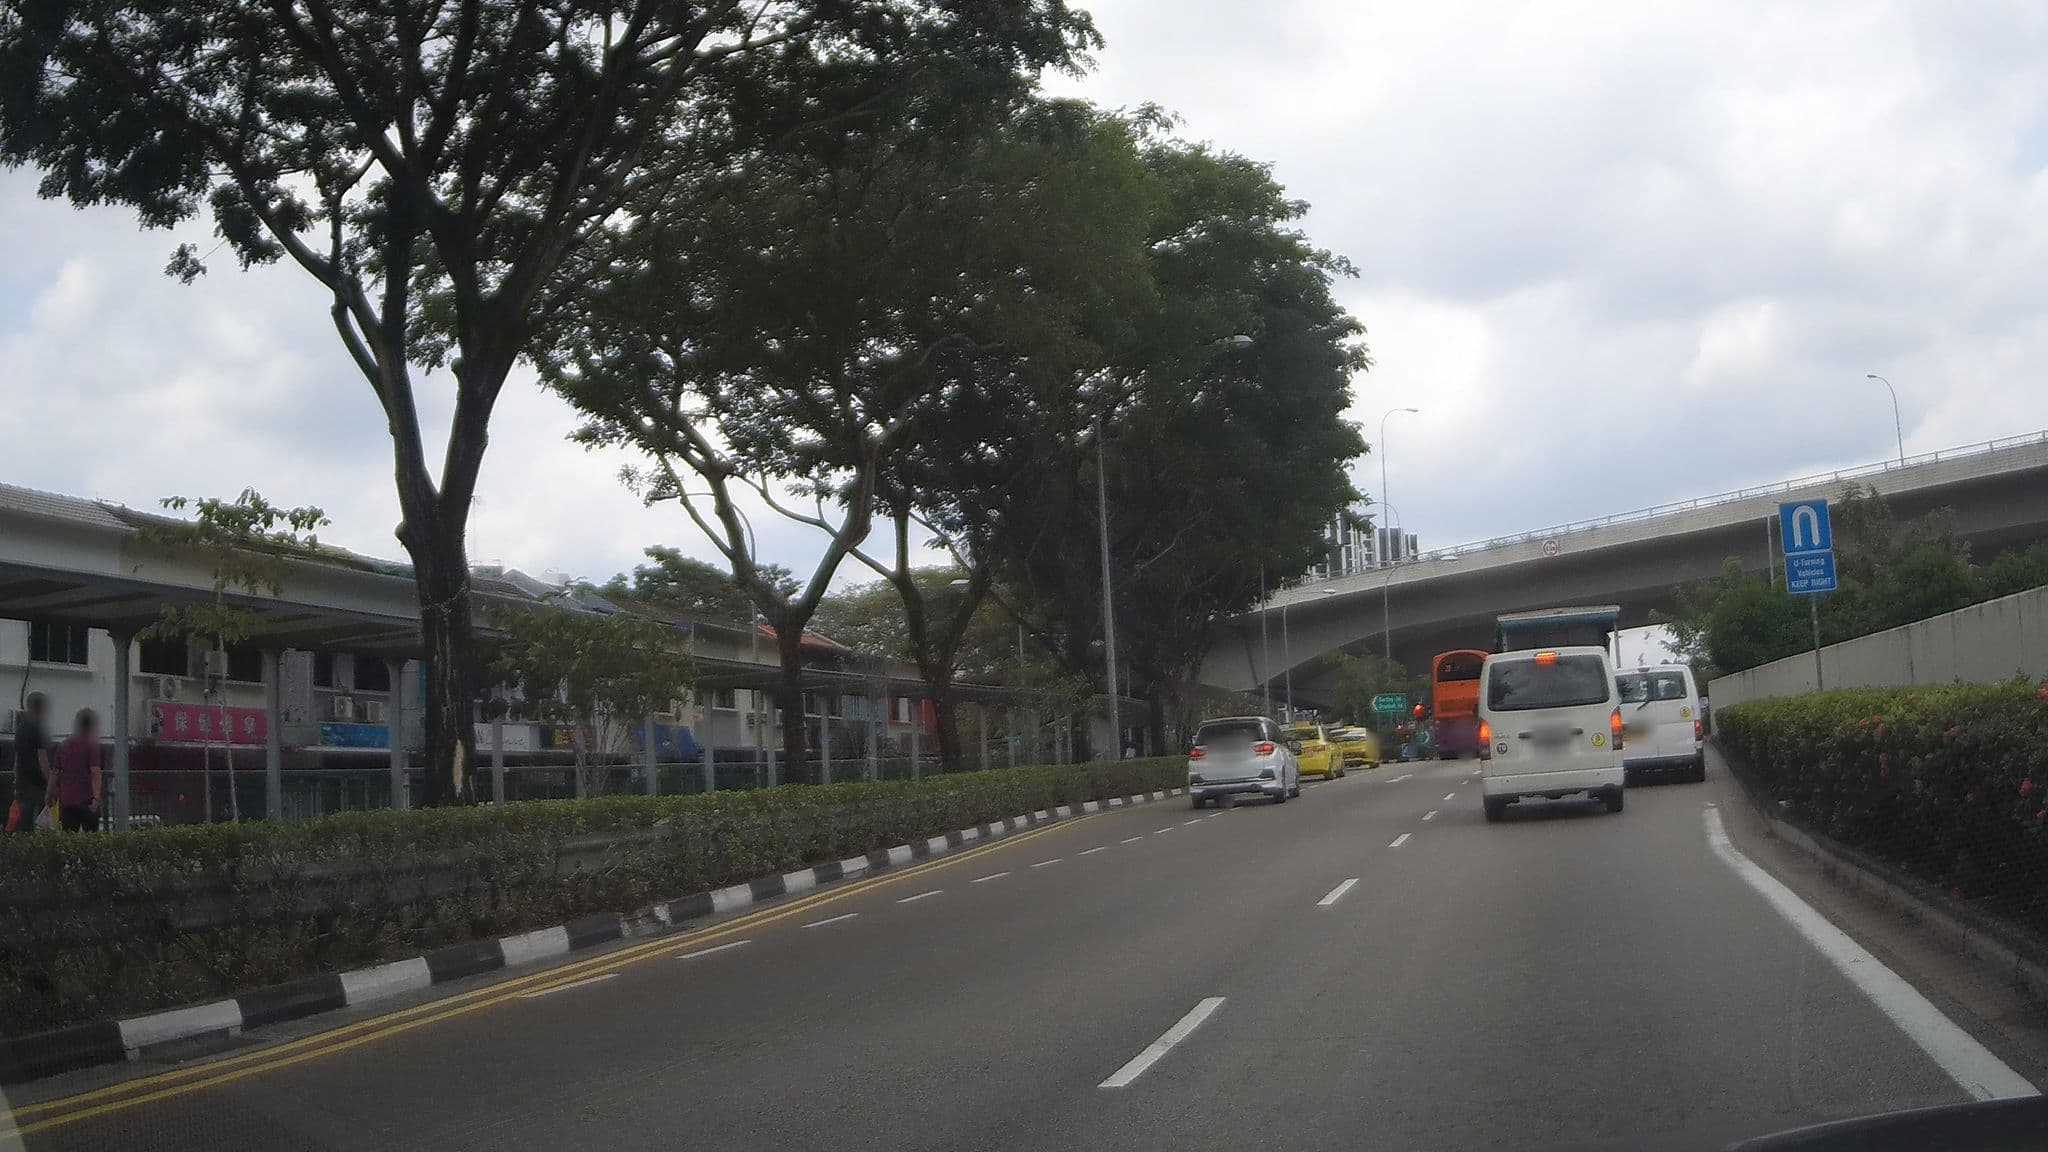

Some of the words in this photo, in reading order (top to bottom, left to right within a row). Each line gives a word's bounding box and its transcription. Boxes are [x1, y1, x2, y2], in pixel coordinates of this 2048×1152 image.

[1797, 569, 1824, 577] Vehicles
[1791, 580, 1808, 588] KEEP
[1811, 577, 1831, 586] RIGHT
